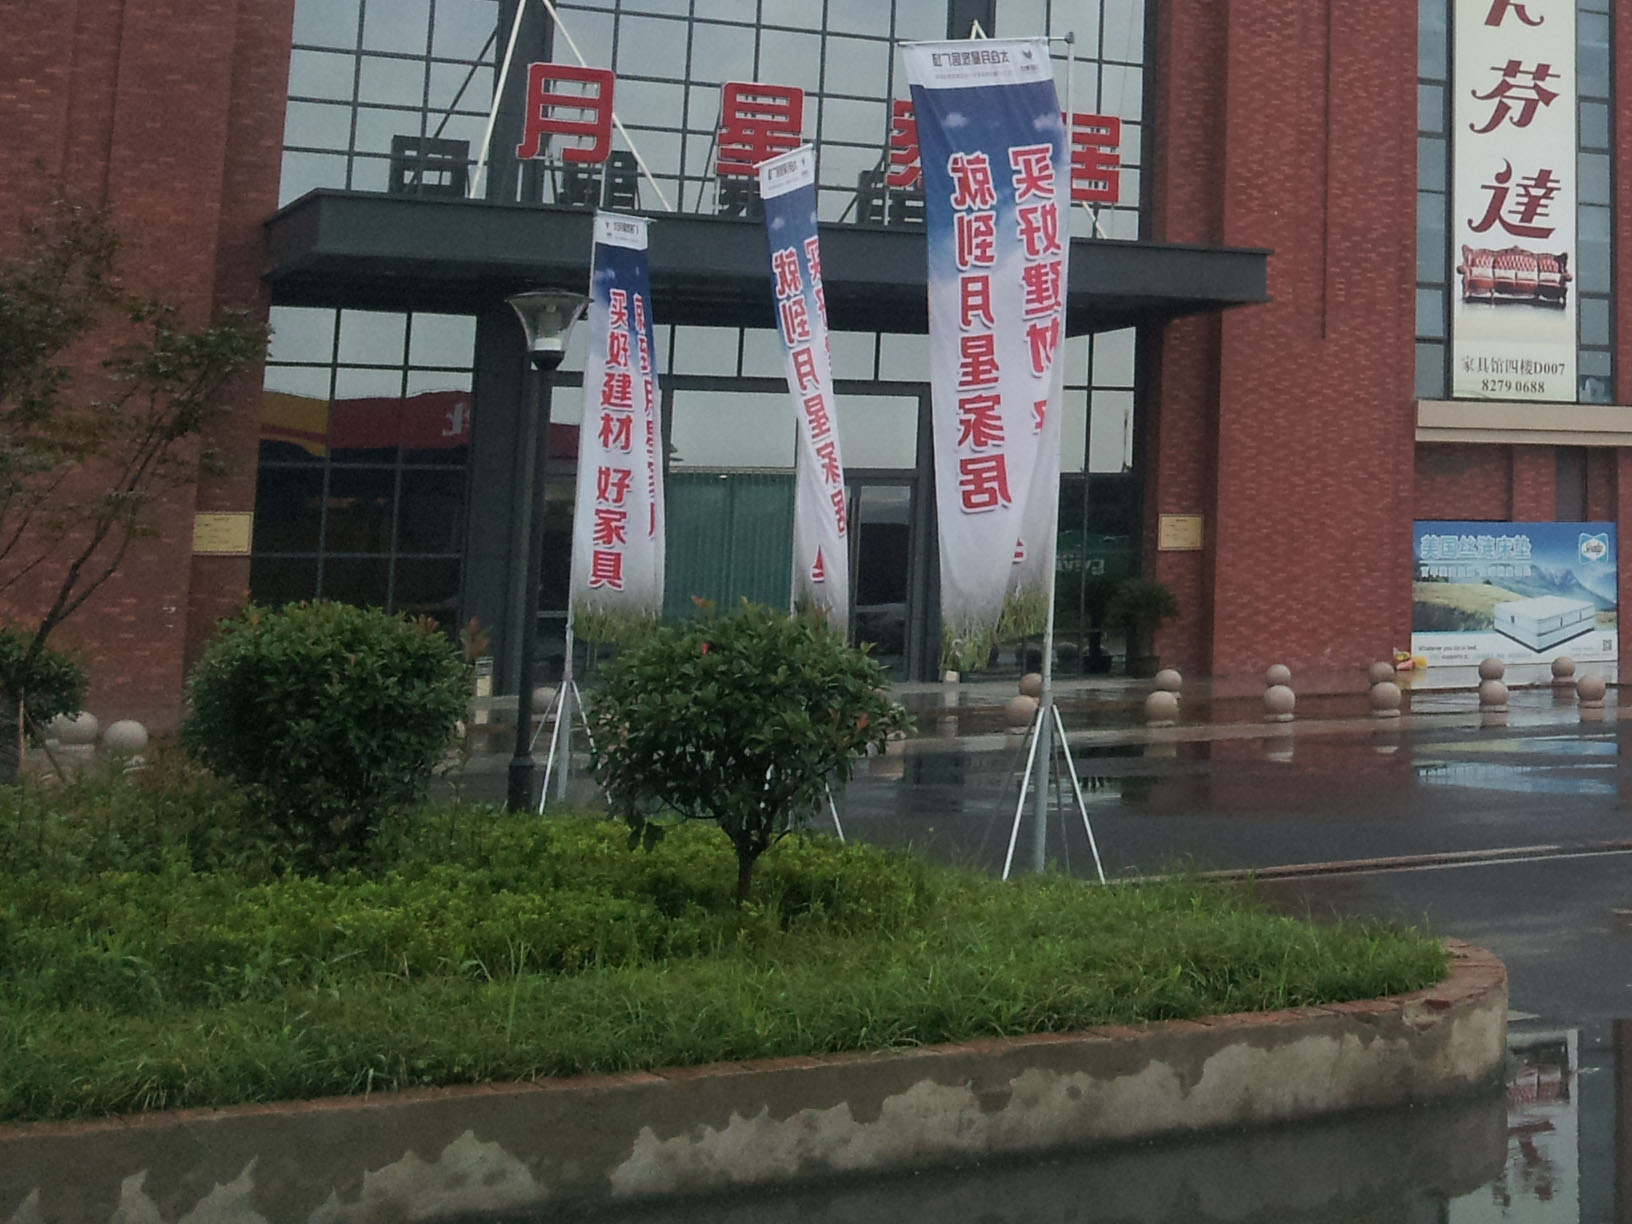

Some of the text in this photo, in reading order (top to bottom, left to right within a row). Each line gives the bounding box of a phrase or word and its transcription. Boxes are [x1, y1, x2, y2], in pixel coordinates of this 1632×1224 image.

[589, 288, 634, 591] 买好建材 好家具
[1482, 378, 1545, 394] 8279 0688
